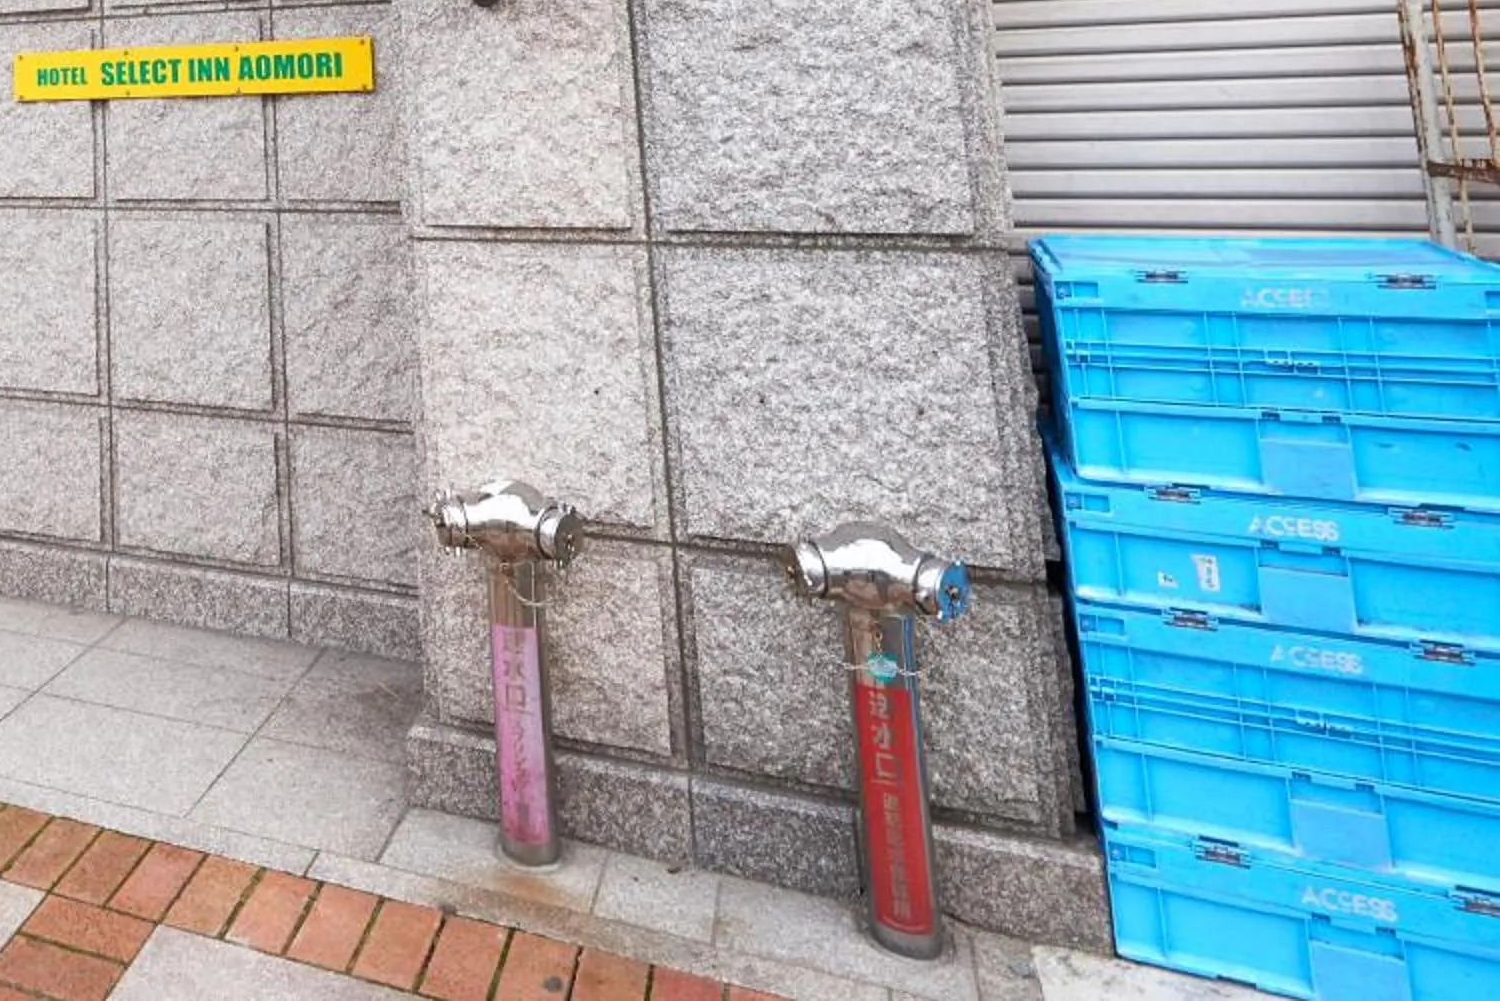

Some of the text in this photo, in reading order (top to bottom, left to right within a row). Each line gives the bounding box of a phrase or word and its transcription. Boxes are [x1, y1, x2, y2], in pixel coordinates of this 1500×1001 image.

[36, 52, 342, 87] HOTEL SELECT INN AOMORI
[1301, 885, 1397, 922] ACCESS
